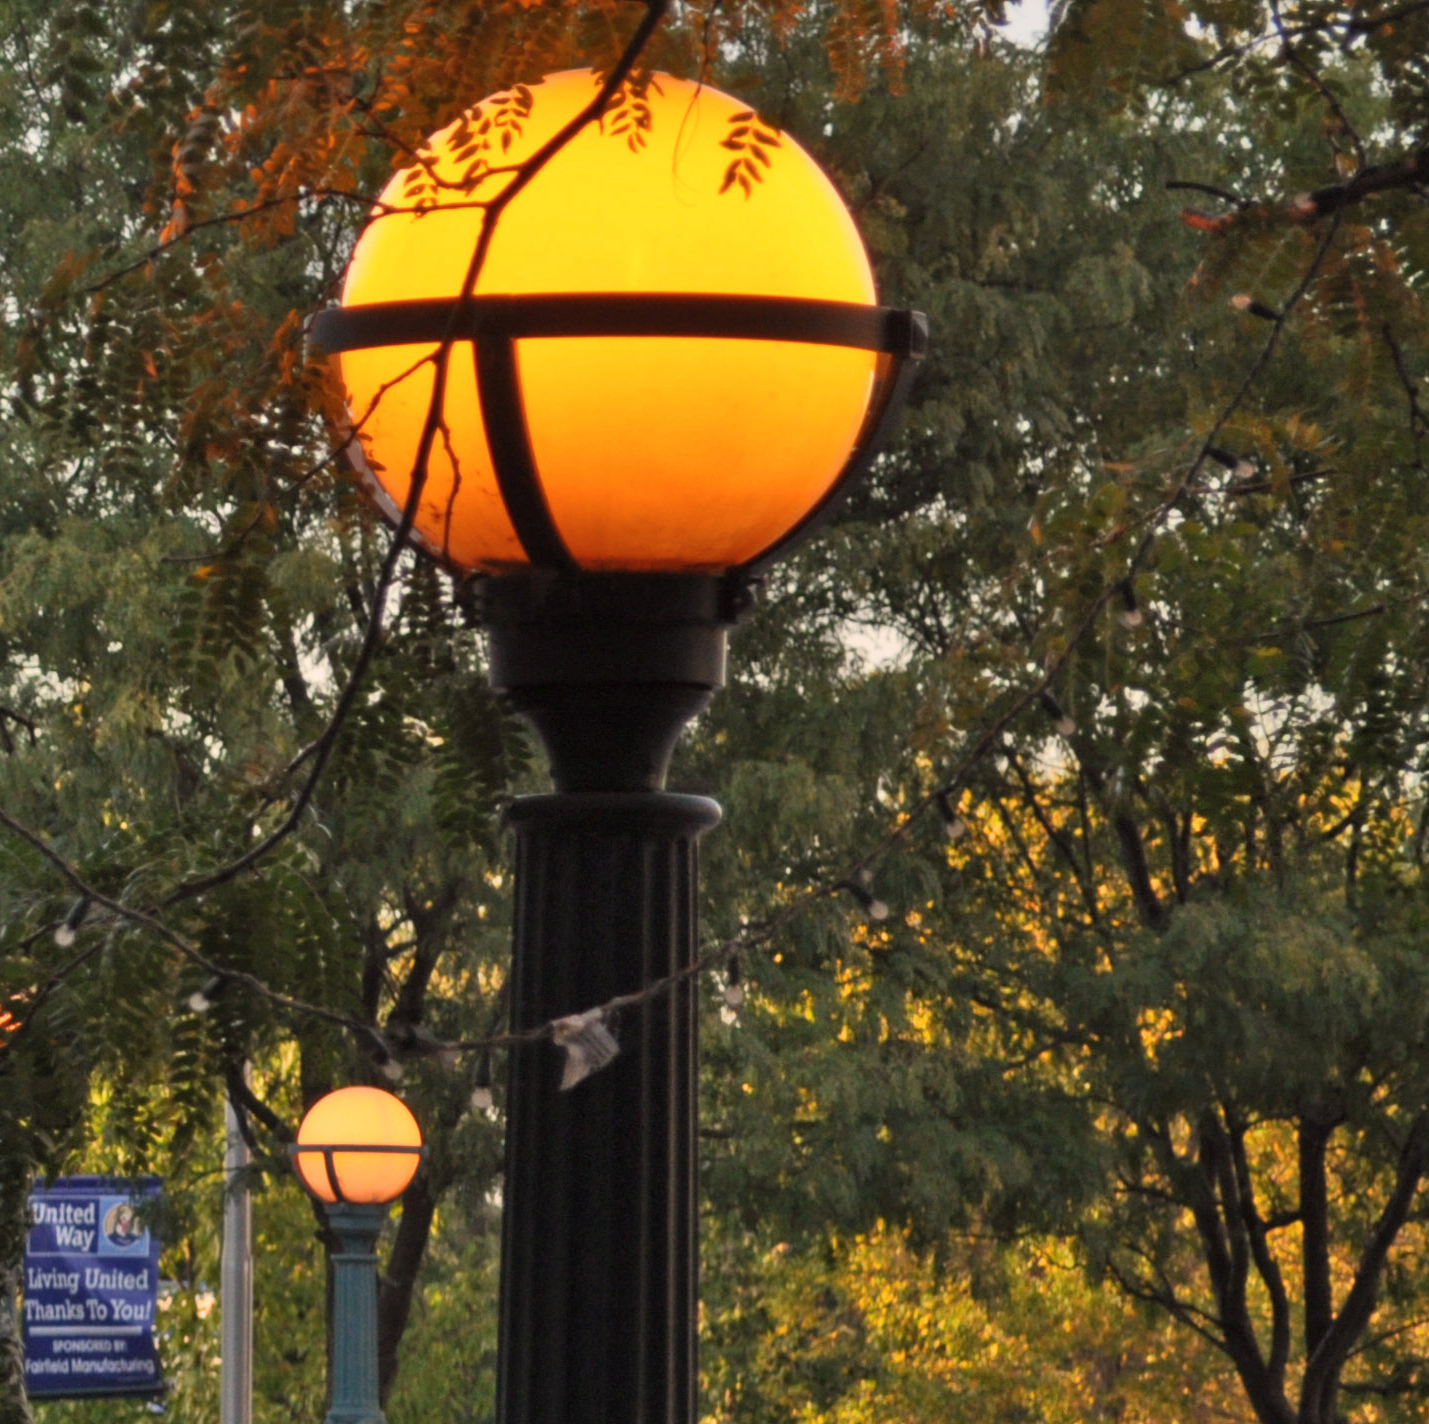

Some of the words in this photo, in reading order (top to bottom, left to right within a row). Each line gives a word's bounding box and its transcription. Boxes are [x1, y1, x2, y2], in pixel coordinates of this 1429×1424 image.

[32, 1203, 95, 1224] United
[56, 1225, 95, 1252] Way
[28, 1267, 80, 1294] Living
[85, 1268, 149, 1290] United
[25, 1299, 84, 1321] Thanks
[86, 1300, 107, 1321] To
[110, 1299, 152, 1321] You!
[52, 1340, 112, 1353] SPONSORED
[25, 1358, 69, 1374] Fairfield
[71, 1358, 155, 1375] Manufacturing
